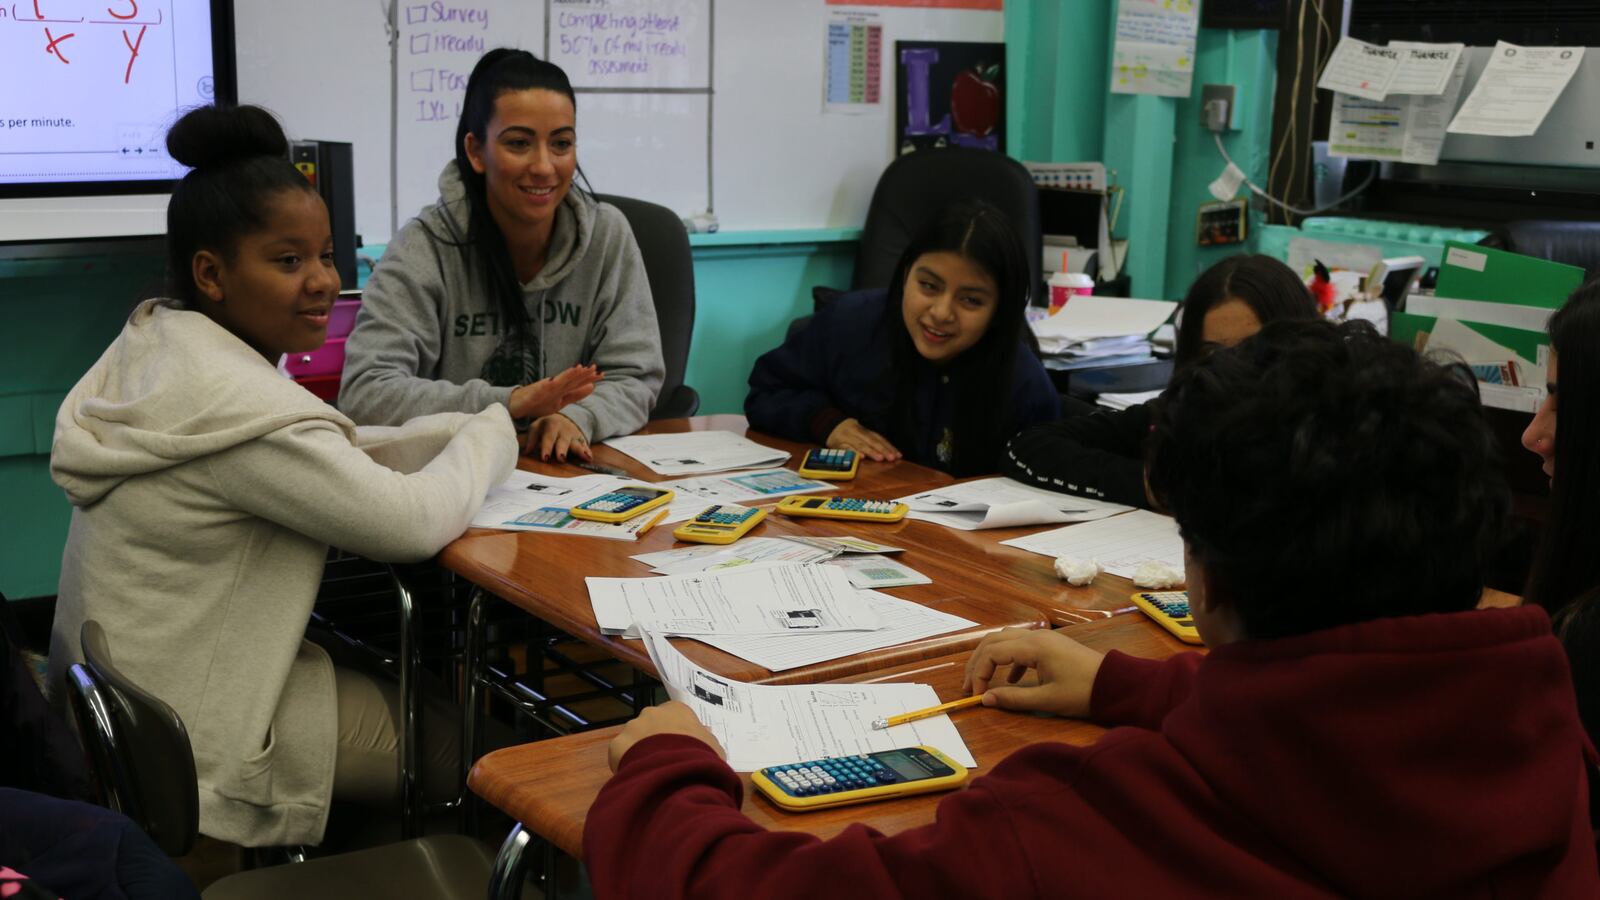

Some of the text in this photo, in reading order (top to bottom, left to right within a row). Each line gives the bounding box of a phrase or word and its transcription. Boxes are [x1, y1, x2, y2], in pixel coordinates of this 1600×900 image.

[431, 1, 488, 30] Survey
[8, 119, 28, 131] per
[31, 116, 76, 128] minute.
